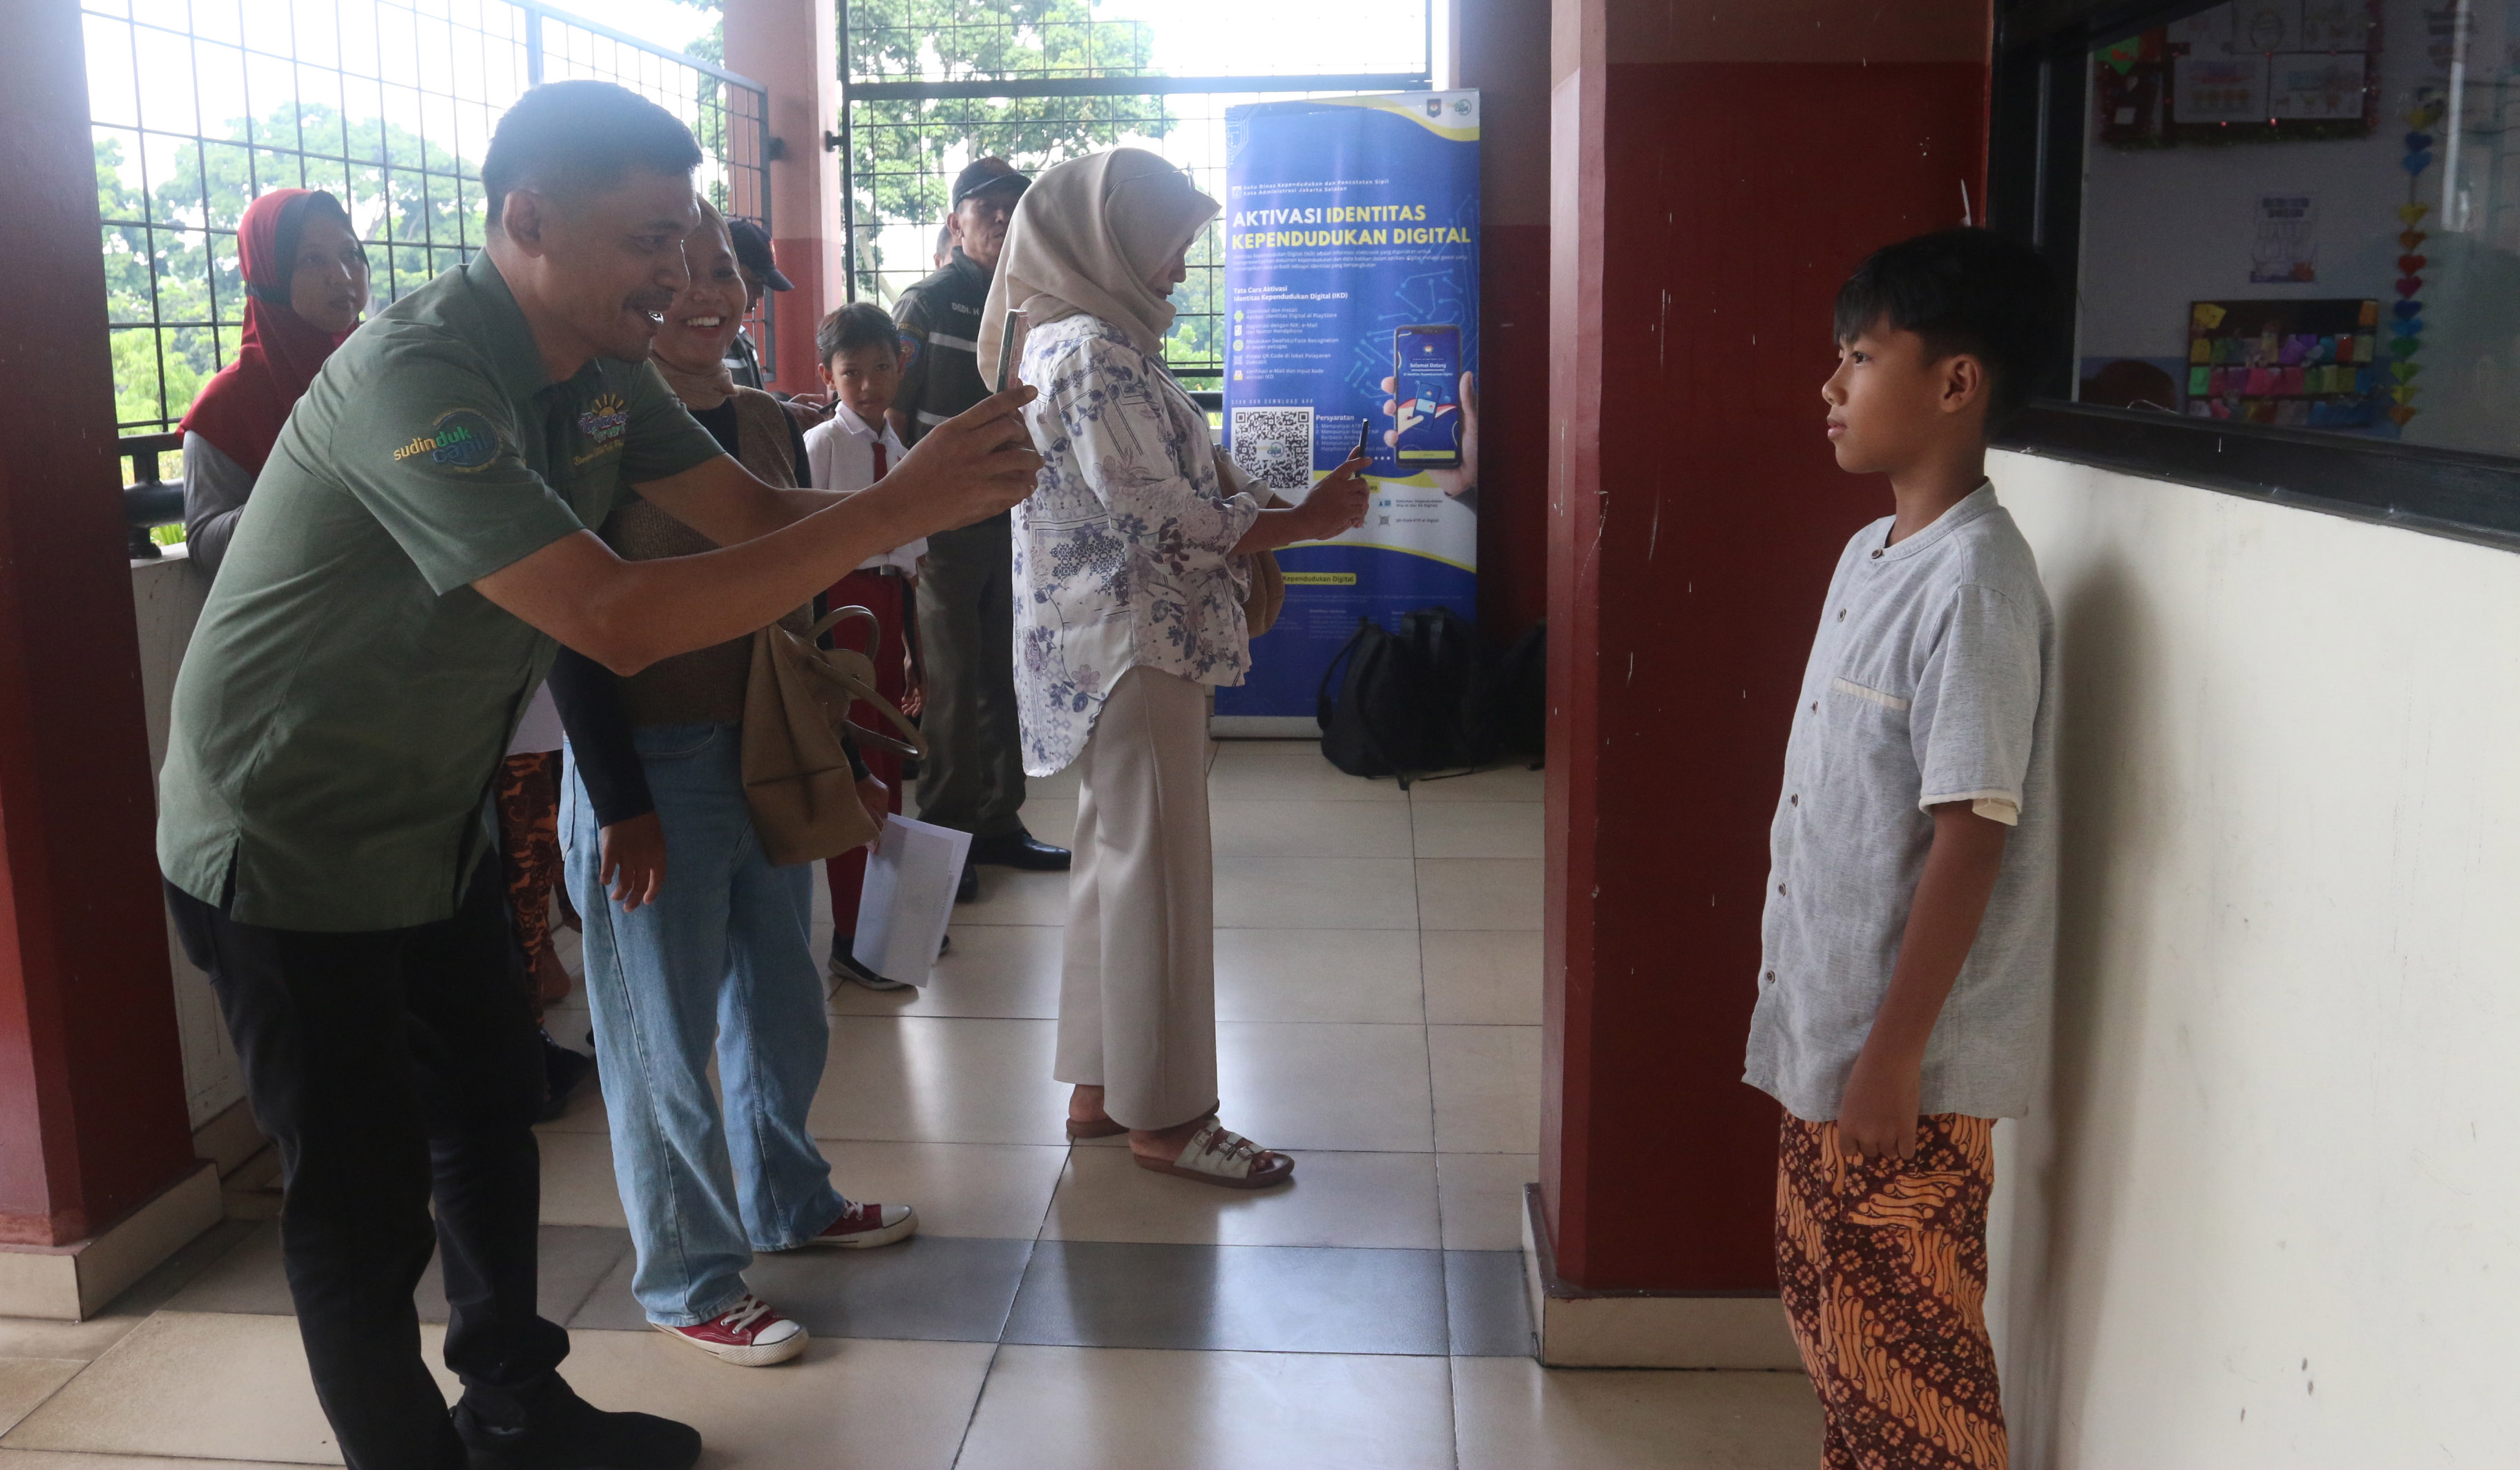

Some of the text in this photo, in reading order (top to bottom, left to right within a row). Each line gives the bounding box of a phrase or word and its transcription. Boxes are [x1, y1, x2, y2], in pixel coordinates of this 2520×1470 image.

[1232, 204, 1426, 227] AKTIVASI IDENTITAS
[1232, 227, 1471, 249] KEPENDUDUKAN DIGITAL
[1310, 293, 1331, 301] Digital
[432, 432, 489, 464] capil
[1332, 574, 1354, 584] Digital
